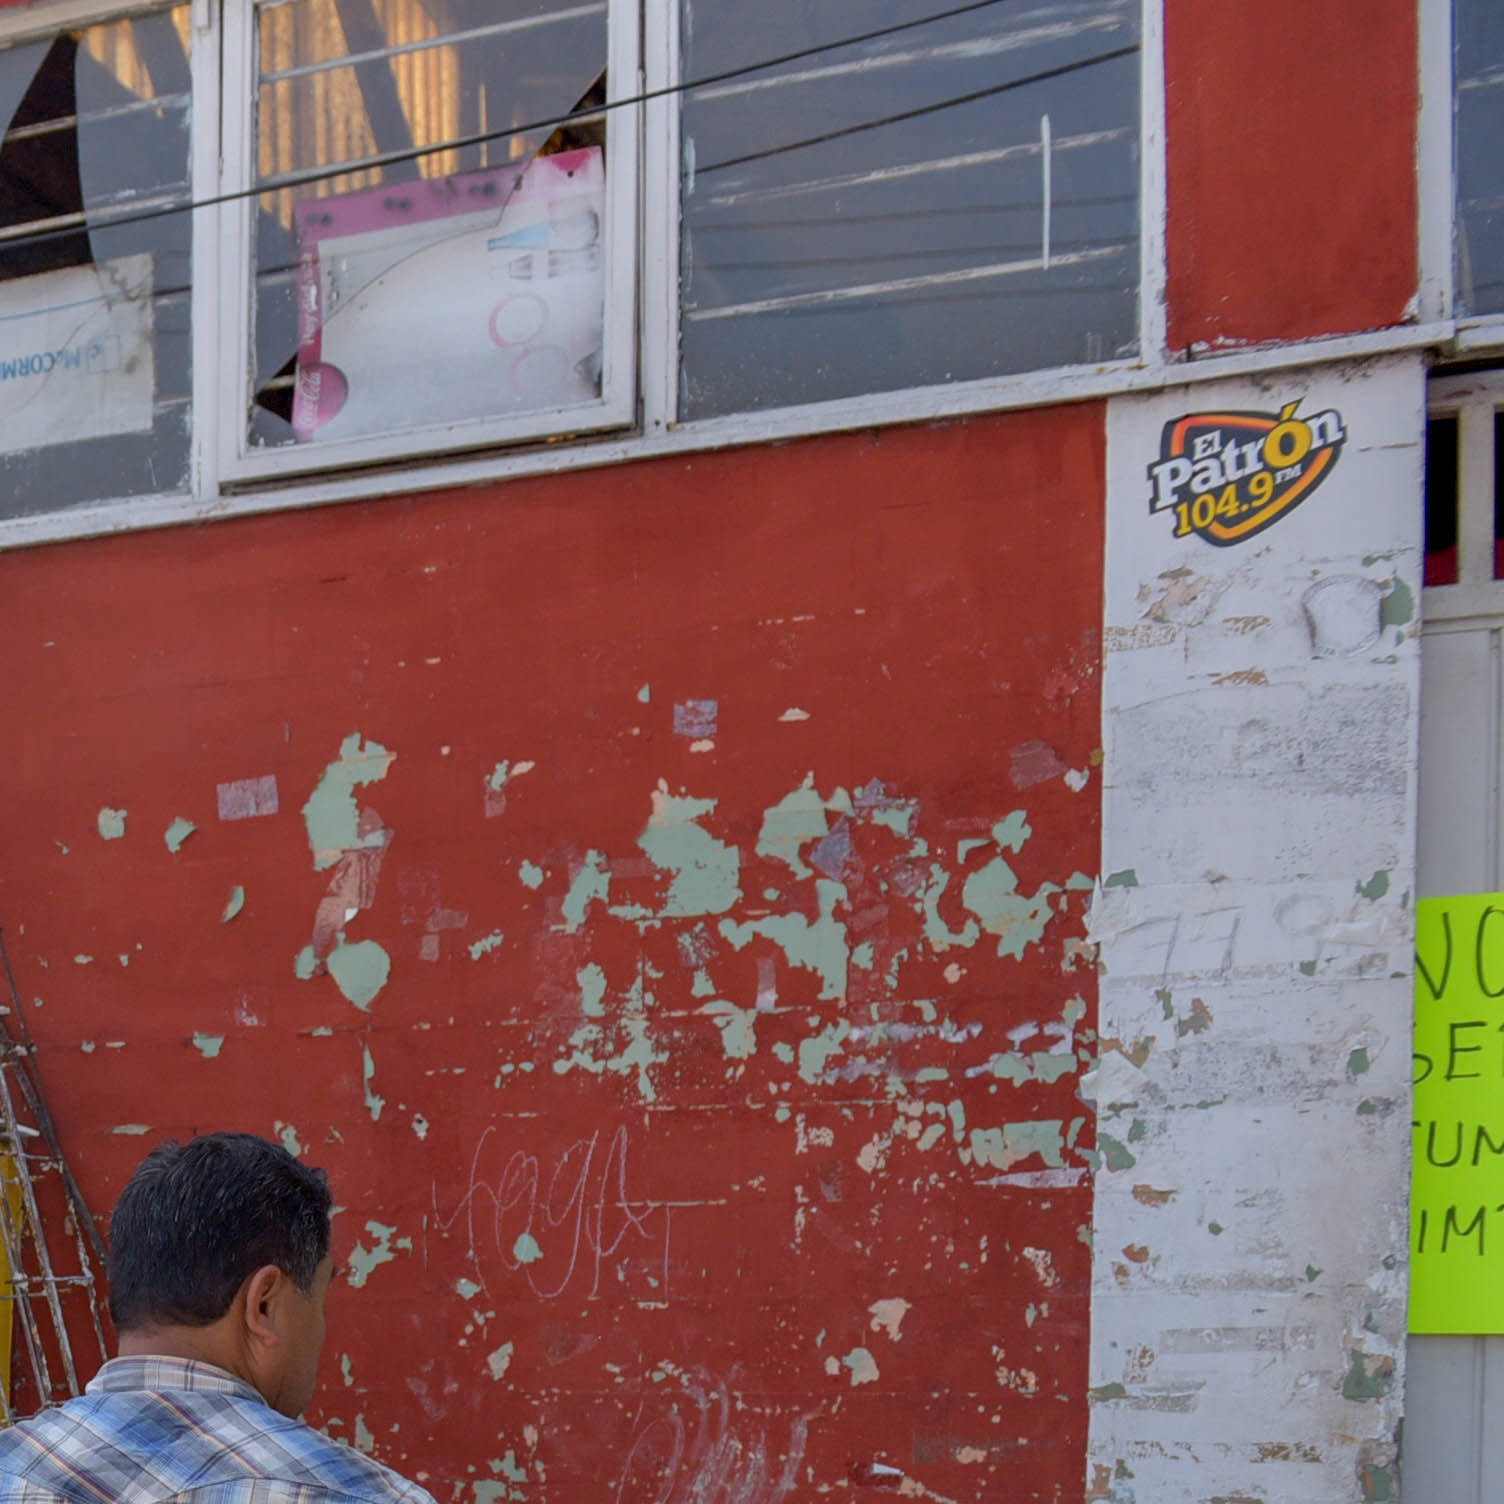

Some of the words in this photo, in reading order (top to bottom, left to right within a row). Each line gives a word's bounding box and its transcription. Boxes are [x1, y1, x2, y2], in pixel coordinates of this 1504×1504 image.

[1150, 398, 1345, 511] Patrón
[1193, 430, 1222, 461] El
[1175, 470, 1276, 537] 104.9
[1418, 1204, 1504, 1257] IM
